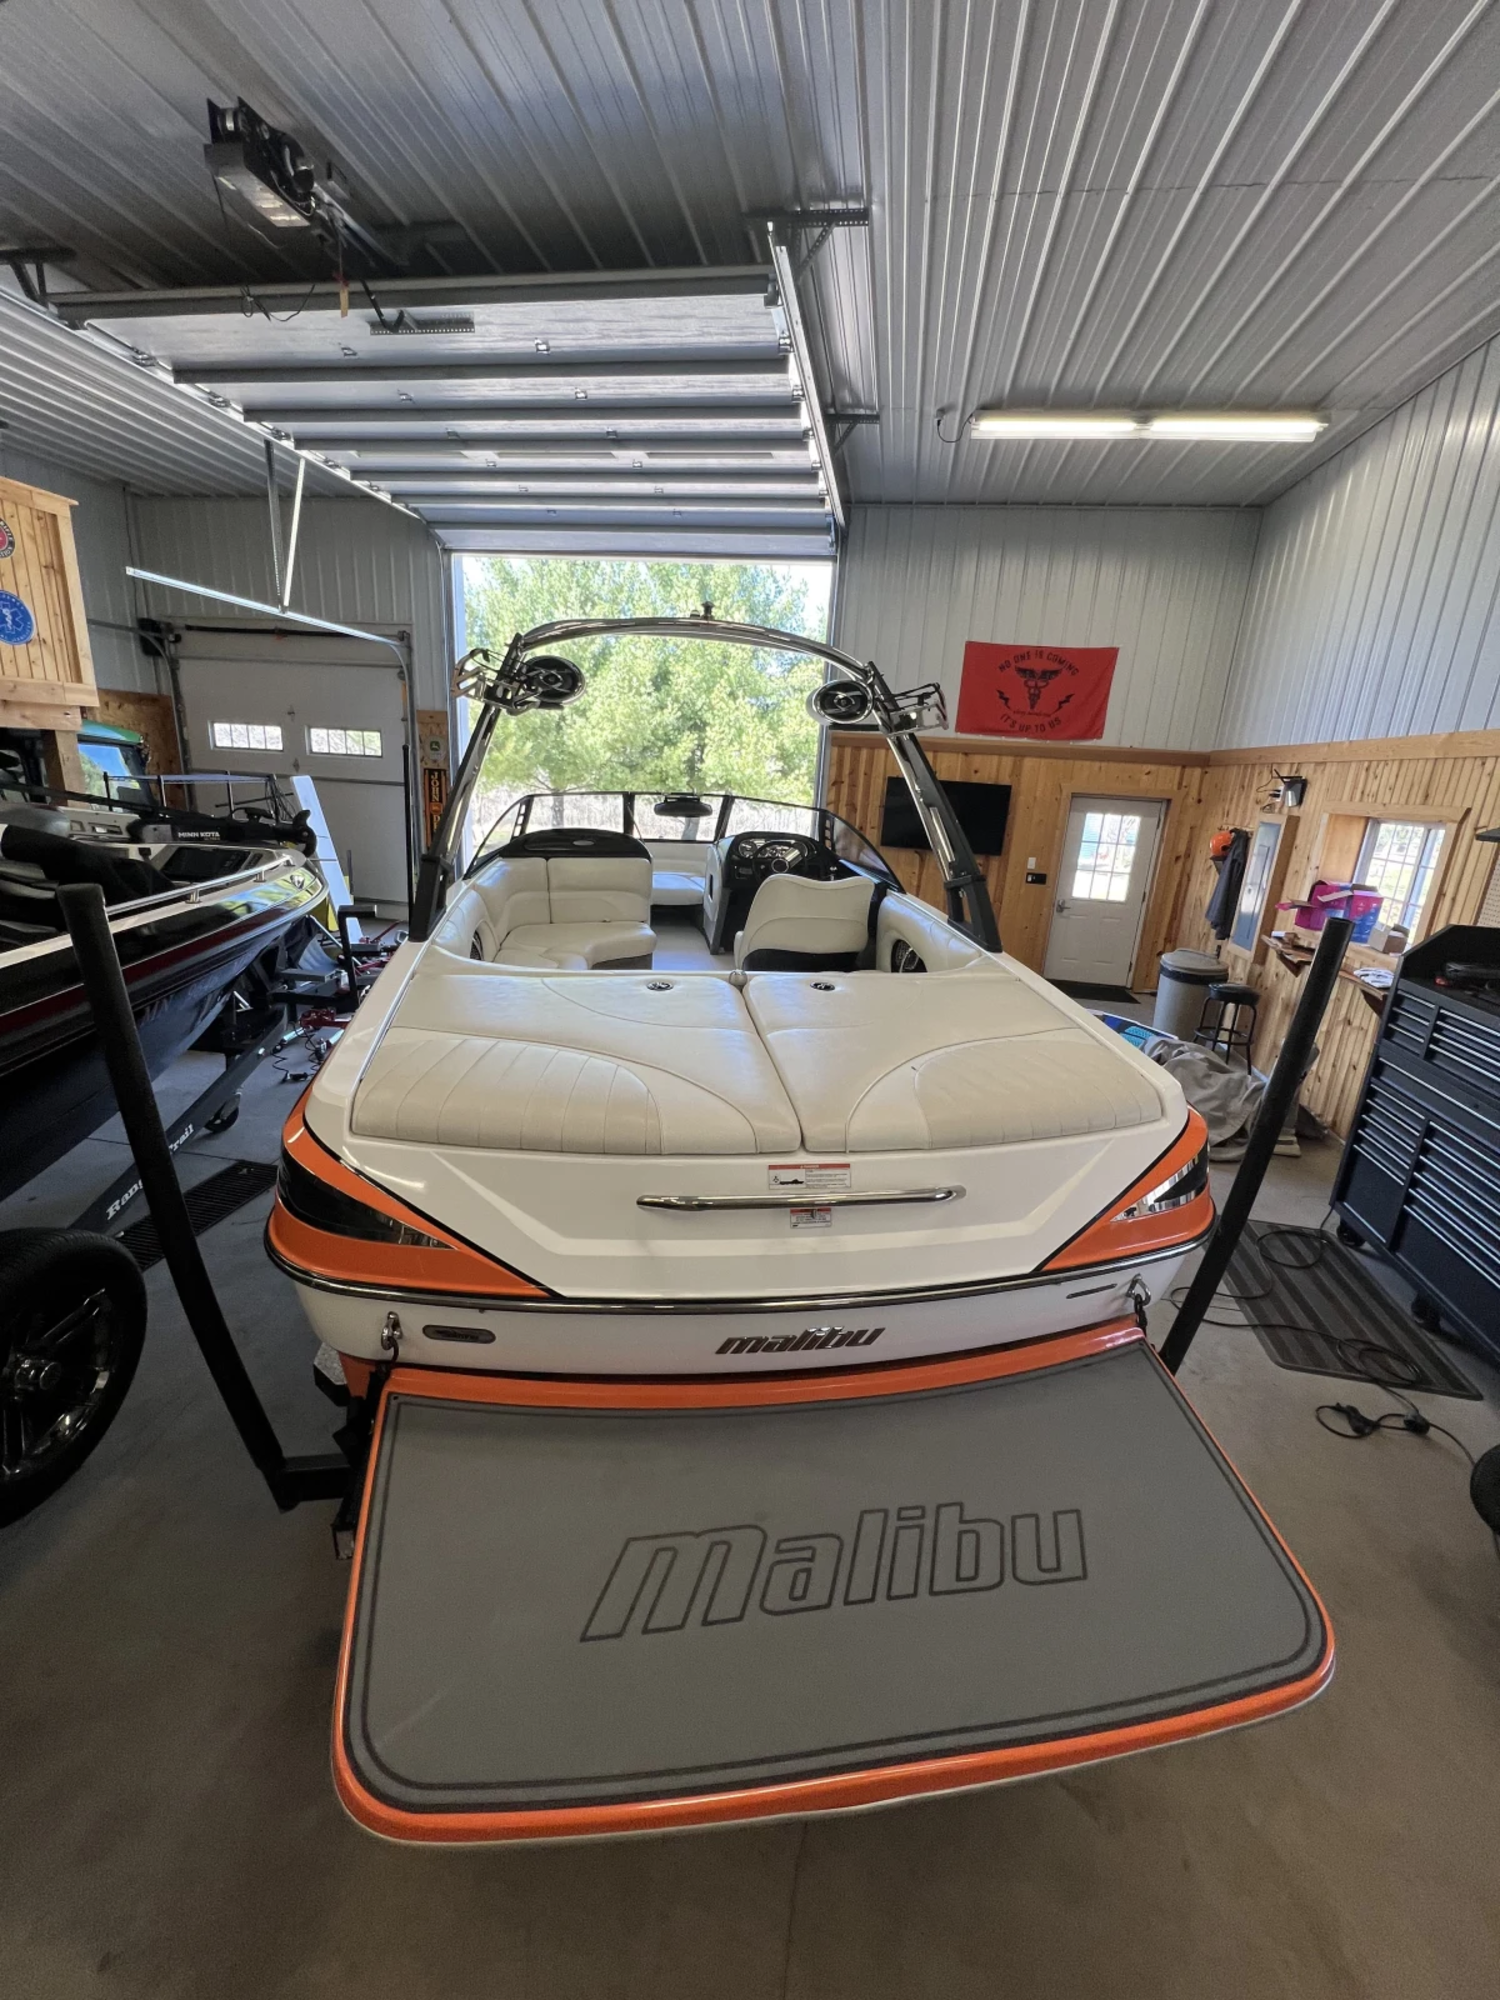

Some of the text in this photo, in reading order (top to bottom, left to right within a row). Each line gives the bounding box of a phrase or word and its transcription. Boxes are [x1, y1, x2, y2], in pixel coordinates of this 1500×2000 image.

[999, 650, 1079, 675] NO ONE IS COMING
[1000, 714, 1061, 733] IT'S UP TO US
[430, 771, 440, 802] JOHN
[715, 1326, 886, 1355] malibu
[579, 1501, 1089, 1644] malibu
